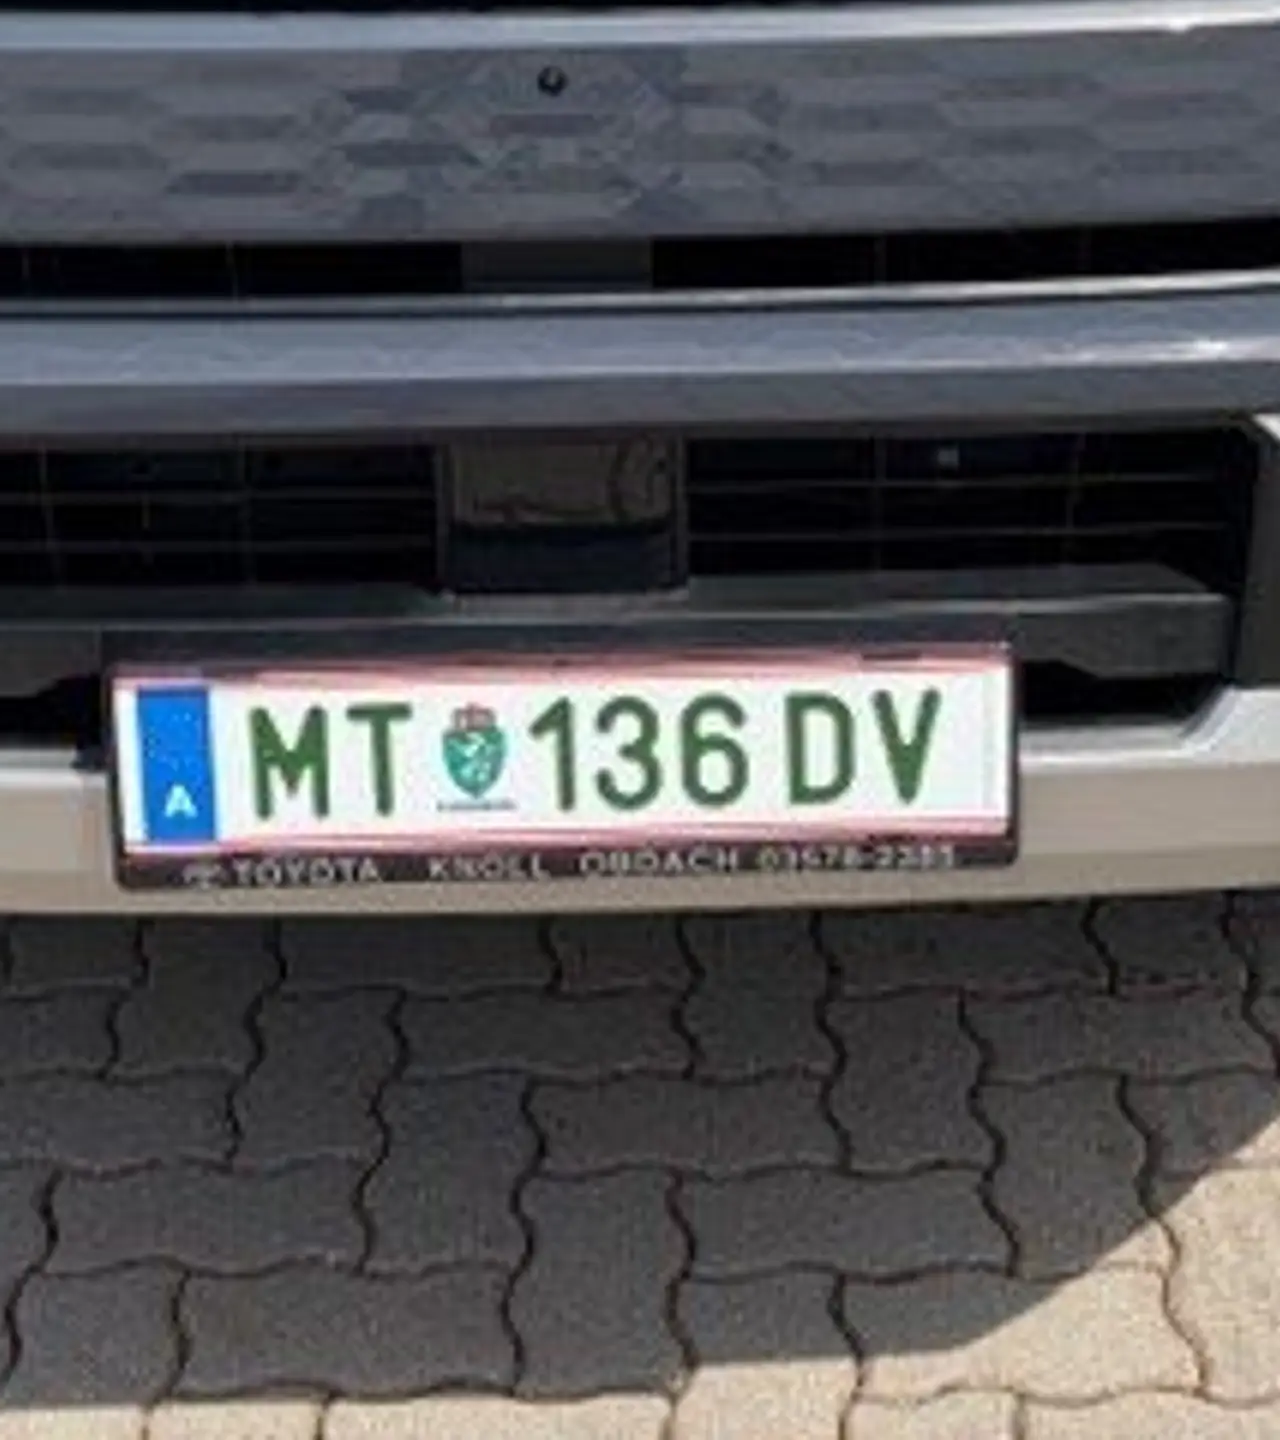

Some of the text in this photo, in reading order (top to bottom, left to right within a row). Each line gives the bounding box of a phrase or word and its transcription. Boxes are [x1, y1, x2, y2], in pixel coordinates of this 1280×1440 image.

[249, 687, 942, 819] MT 136 DV
[163, 783, 198, 818] A
[233, 855, 384, 886] TOYOTA
